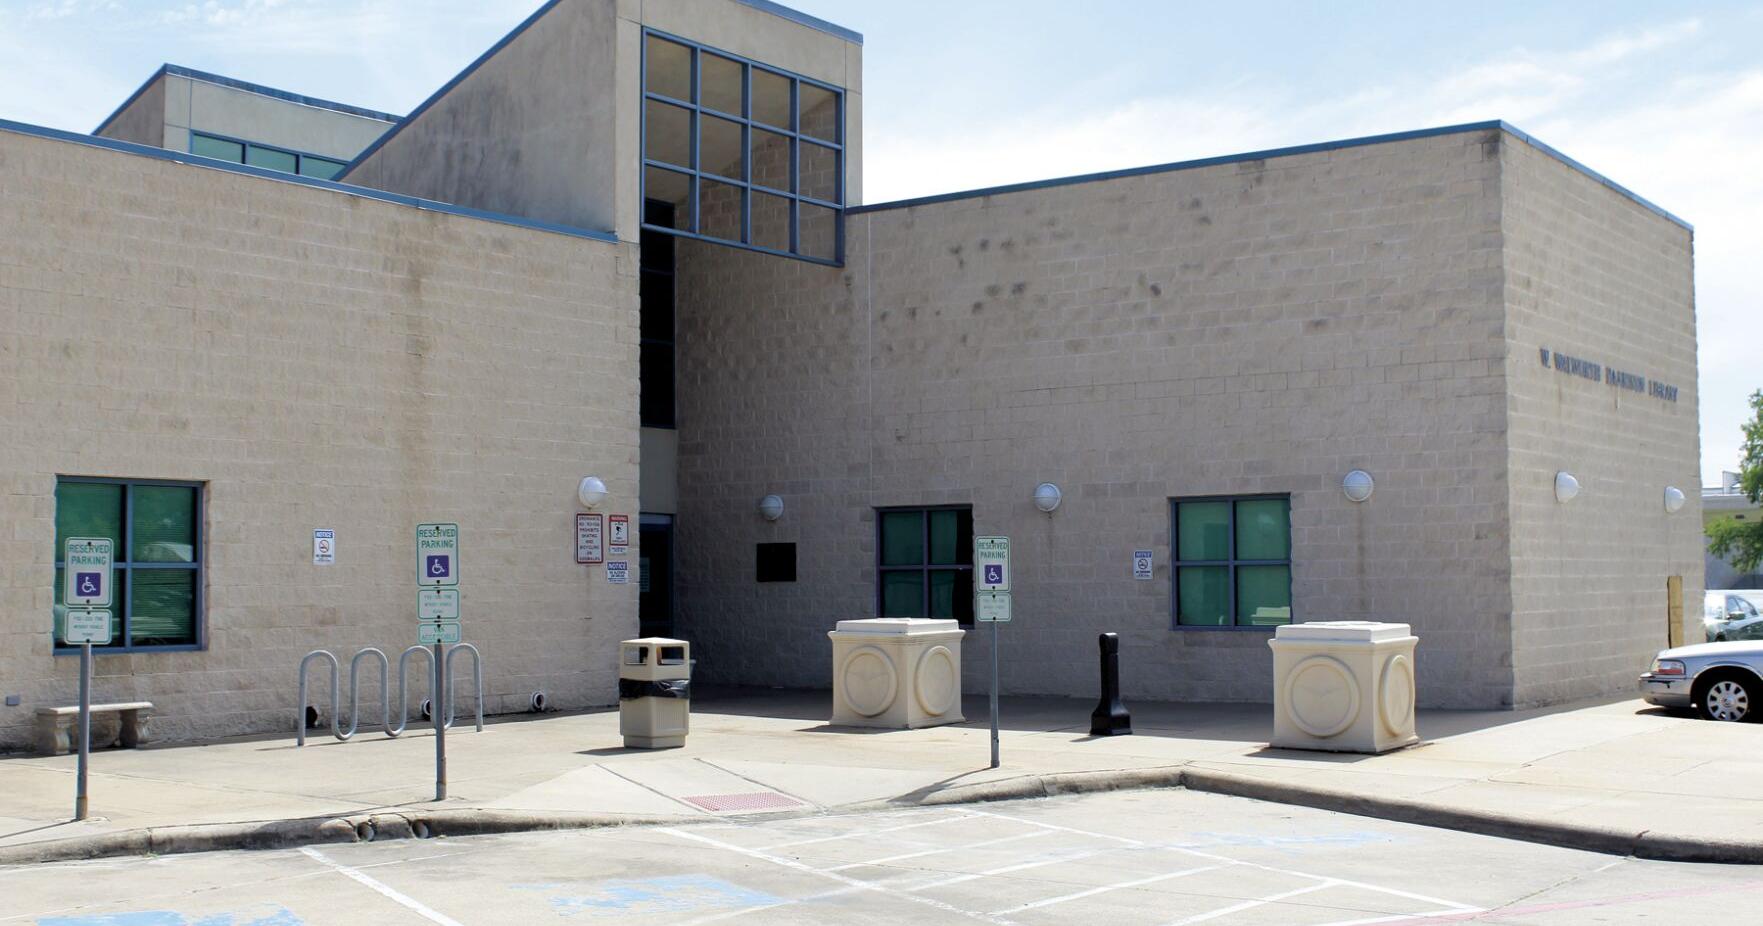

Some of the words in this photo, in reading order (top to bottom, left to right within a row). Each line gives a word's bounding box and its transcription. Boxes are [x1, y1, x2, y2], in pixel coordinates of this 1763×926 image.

[419, 529, 456, 538] RESERVED
[421, 540, 454, 548] PARKING
[69, 544, 110, 554] RESERVED
[71, 556, 106, 565] PARKING
[980, 552, 1006, 560] PARKING
